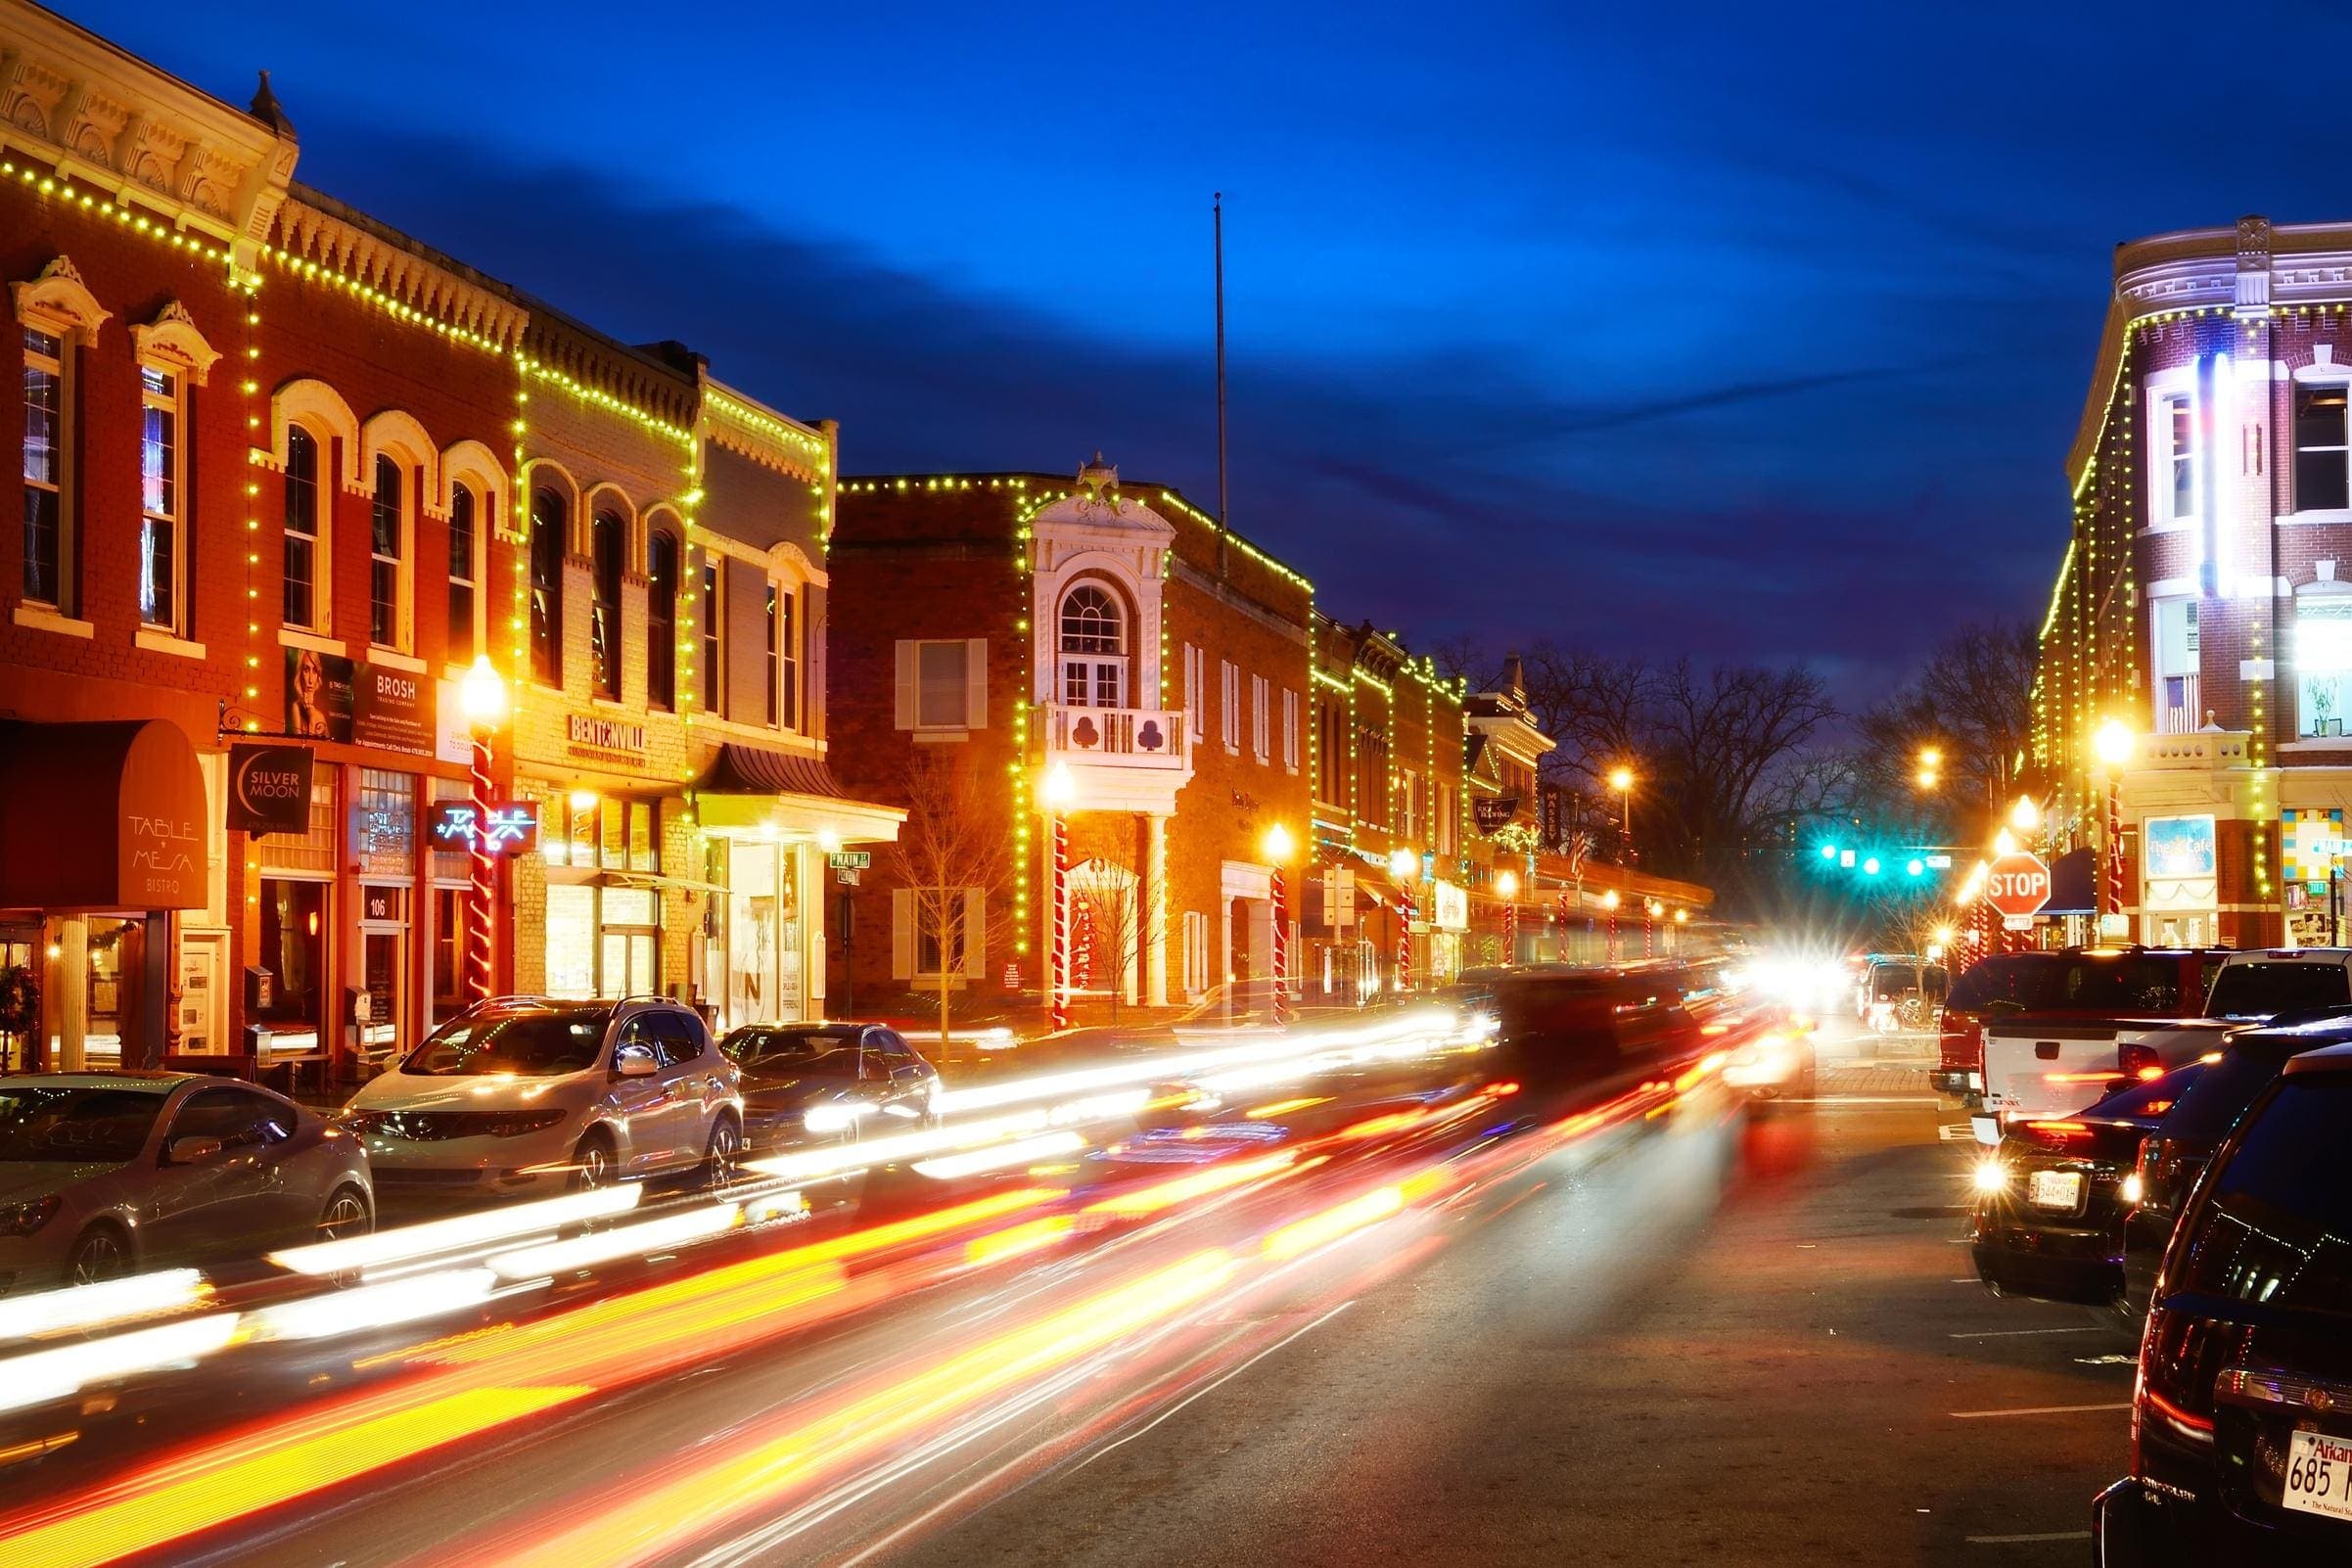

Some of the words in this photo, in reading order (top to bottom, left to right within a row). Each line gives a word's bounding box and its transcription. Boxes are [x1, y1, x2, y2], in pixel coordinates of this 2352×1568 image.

[377, 674, 415, 699] BROSH
[377, 696, 395, 705] TRADING
[251, 771, 300, 786] SILVER
[250, 784, 300, 798] MOON
[1546, 793, 1557, 840] MASSEY
[128, 815, 199, 841] TABLE
[133, 850, 195, 873] MESA
[837, 853, 858, 866] MAIN
[147, 878, 179, 894] BISTRO
[1990, 873, 2046, 897] STOP
[371, 899, 386, 916] 106
[2291, 1456, 2331, 1497] 685
[2324, 1503, 2344, 1515] Natural
